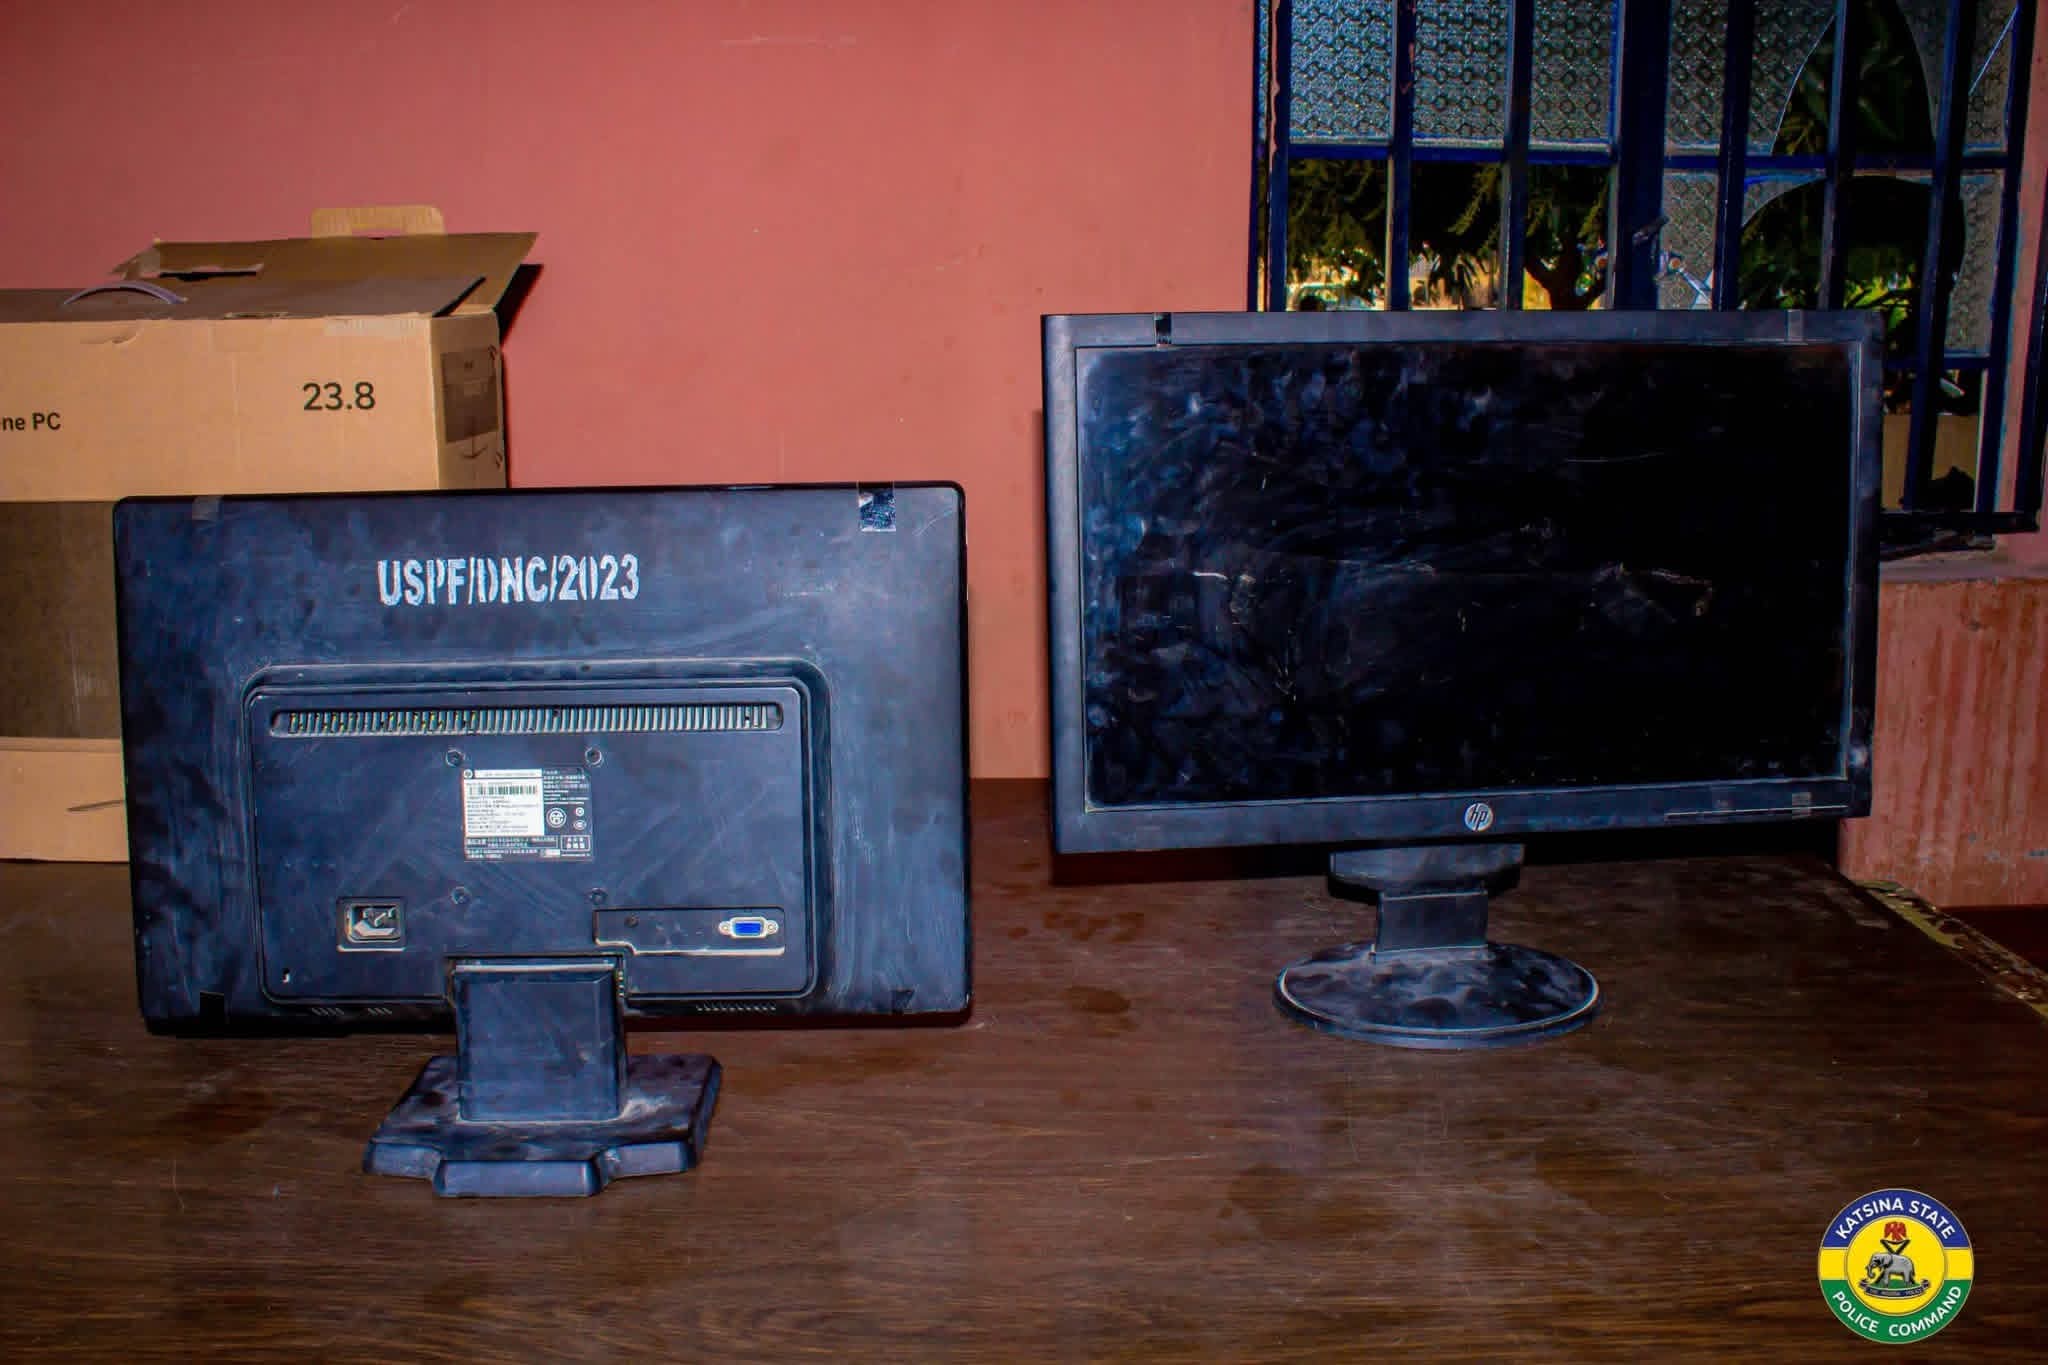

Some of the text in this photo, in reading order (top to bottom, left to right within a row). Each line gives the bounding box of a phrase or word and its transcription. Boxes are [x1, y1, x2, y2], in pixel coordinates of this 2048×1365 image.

[302, 382, 376, 411] 23.8
[0, 412, 62, 431] ne PC
[377, 554, 640, 606] USPF/DNC/2023
[1467, 803, 1491, 831] hp
